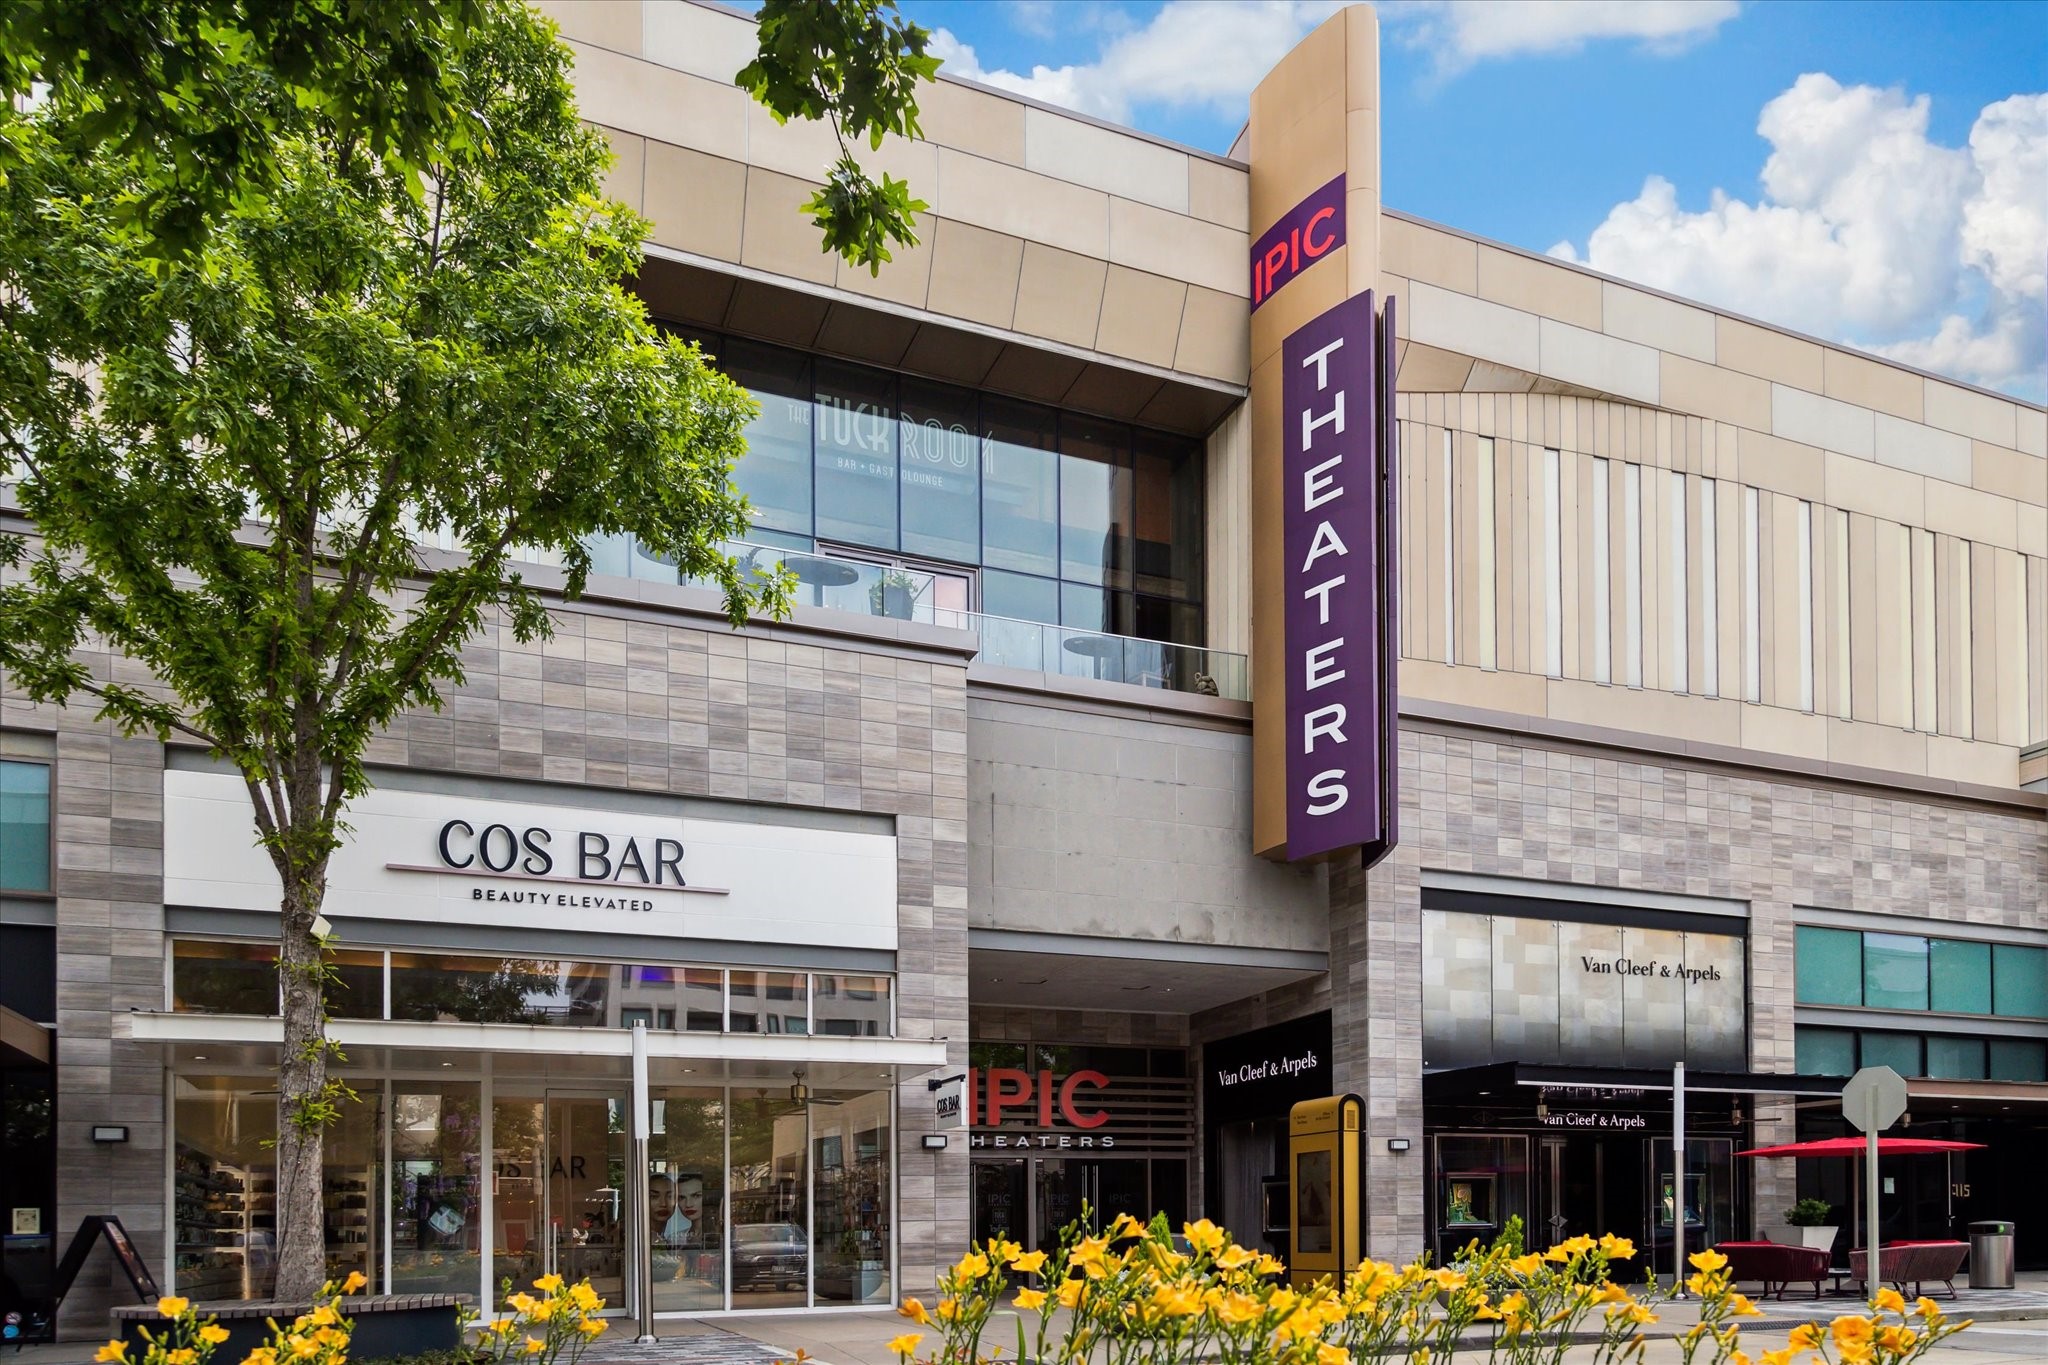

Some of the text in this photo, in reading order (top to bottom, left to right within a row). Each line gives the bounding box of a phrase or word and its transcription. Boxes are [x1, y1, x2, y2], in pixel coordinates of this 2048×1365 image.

[1254, 206, 1336, 305] IPIC
[787, 392, 994, 475] THE TUCK ROOM
[836, 457, 857, 471] BAR
[868, 462, 944, 488] GASTOLOUNGE
[1301, 336, 1349, 817] THEATERS
[438, 819, 687, 887] COS BAR
[472, 887, 654, 912] BEAUTY ELEVATED
[1581, 955, 1721, 985] Van Cleef & Arpels
[1218, 1050, 1318, 1087] Van Cleef & Arpels
[948, 1094, 961, 1111] BAR
[1599, 1115, 1609, 1127] &
[1609, 1114, 1646, 1131] Arpels
[970, 1134, 1116, 1148] HEATERS
[548, 1155, 587, 1180] AR
